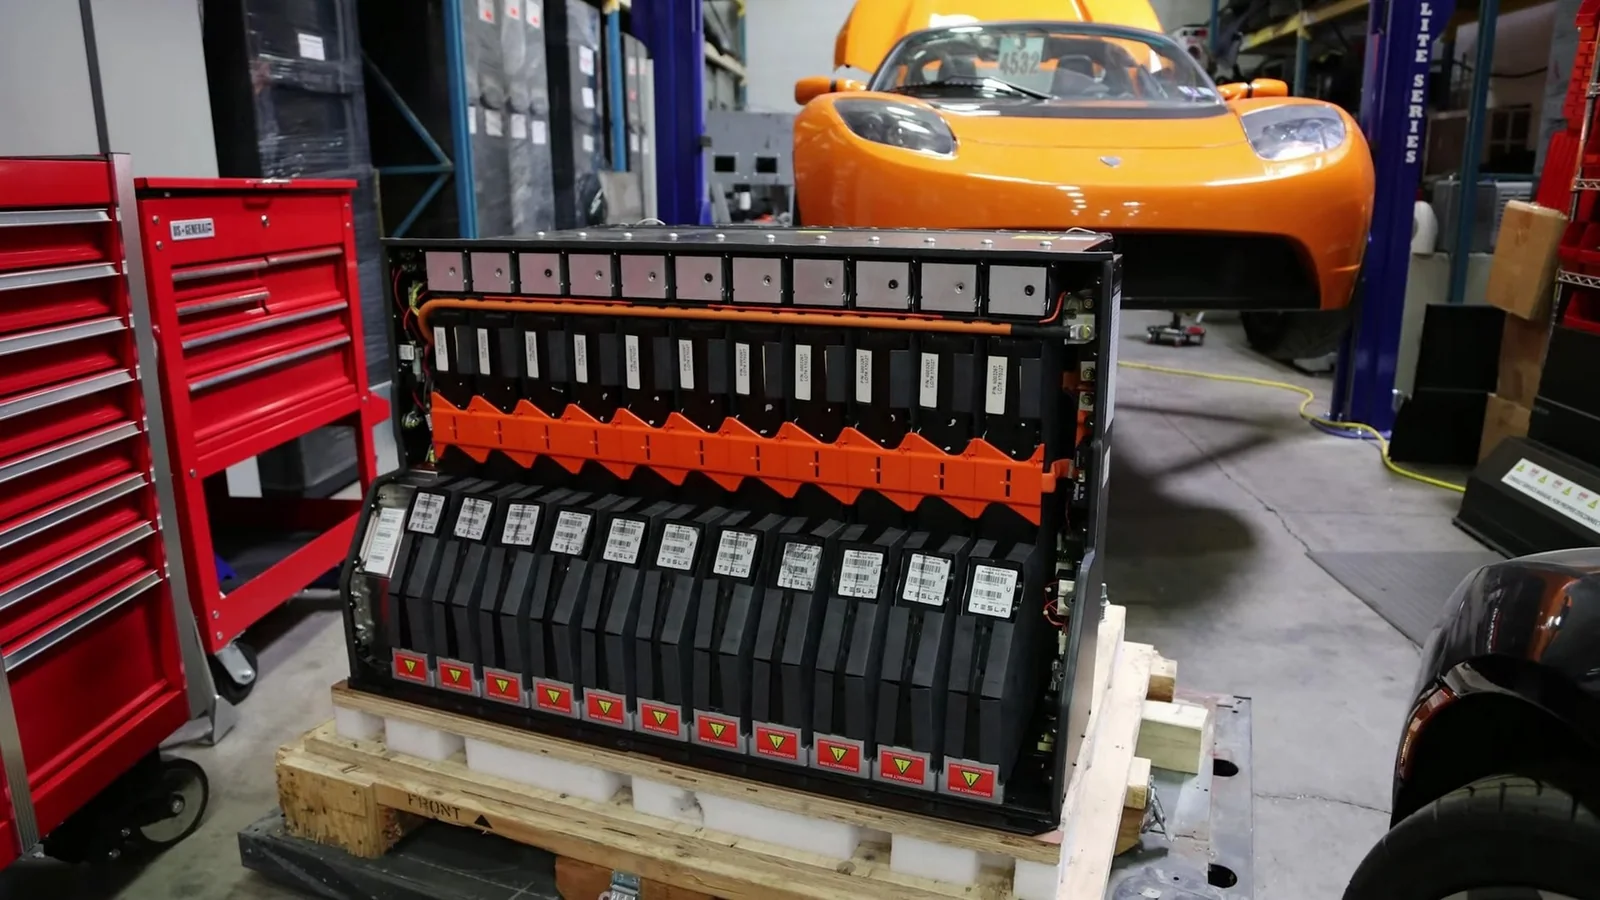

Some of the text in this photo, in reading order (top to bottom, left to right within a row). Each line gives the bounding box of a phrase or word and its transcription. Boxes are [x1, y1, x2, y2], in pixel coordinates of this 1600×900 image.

[1000, 51, 1040, 75] 4532
[1405, 74, 1424, 163] SERIES
[172, 225, 181, 236] US
[506, 535, 530, 543] TESLA
[555, 543, 580, 552] TESLA
[608, 551, 634, 560] TESLA
[661, 557, 689, 566] TESLA
[718, 564, 747, 574] TESLA
[782, 578, 812, 587] TESLA
[843, 586, 874, 595] TESLA
[908, 590, 940, 601] TESLA
[973, 602, 1007, 613] TESLA
[408, 793, 460, 820] FRONT
